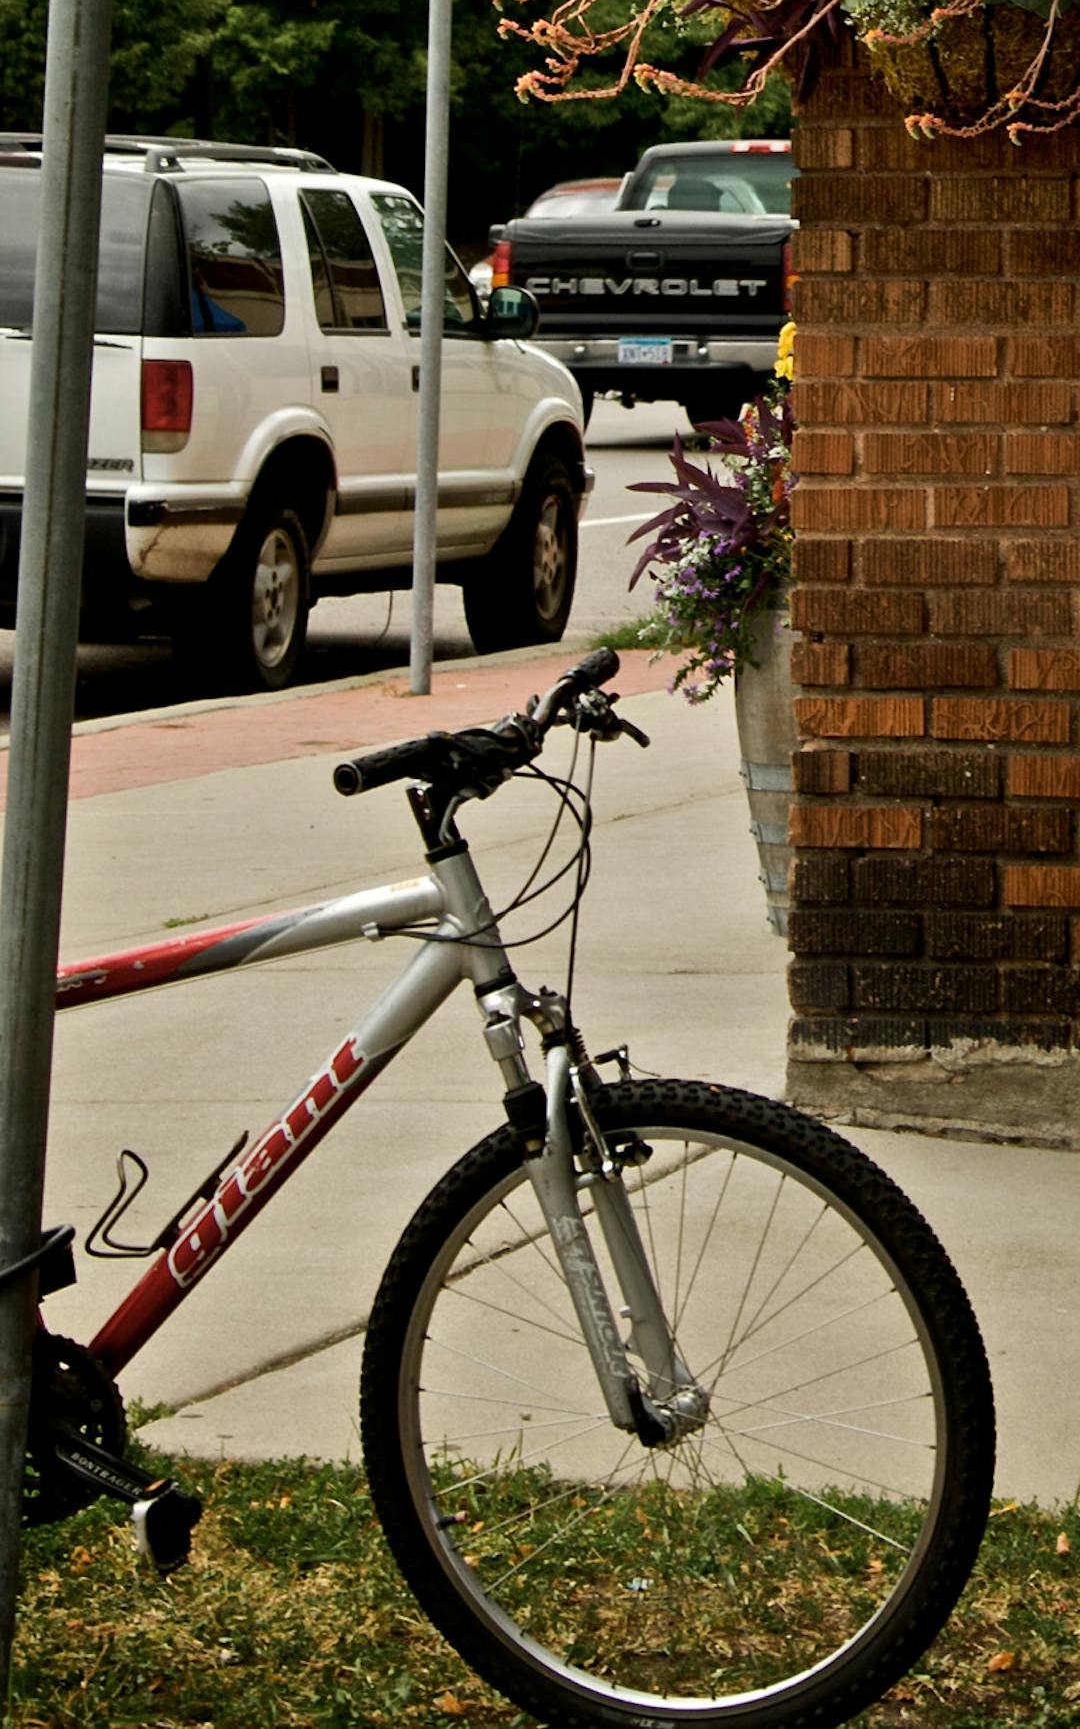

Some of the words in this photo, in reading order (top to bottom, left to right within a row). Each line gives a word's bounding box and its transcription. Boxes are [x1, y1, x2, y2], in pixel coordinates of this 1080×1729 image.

[525, 277, 767, 297] CHEVROLET
[168, 1032, 368, 1289] giant
[70, 1451, 144, 1496] BONTRAGER
